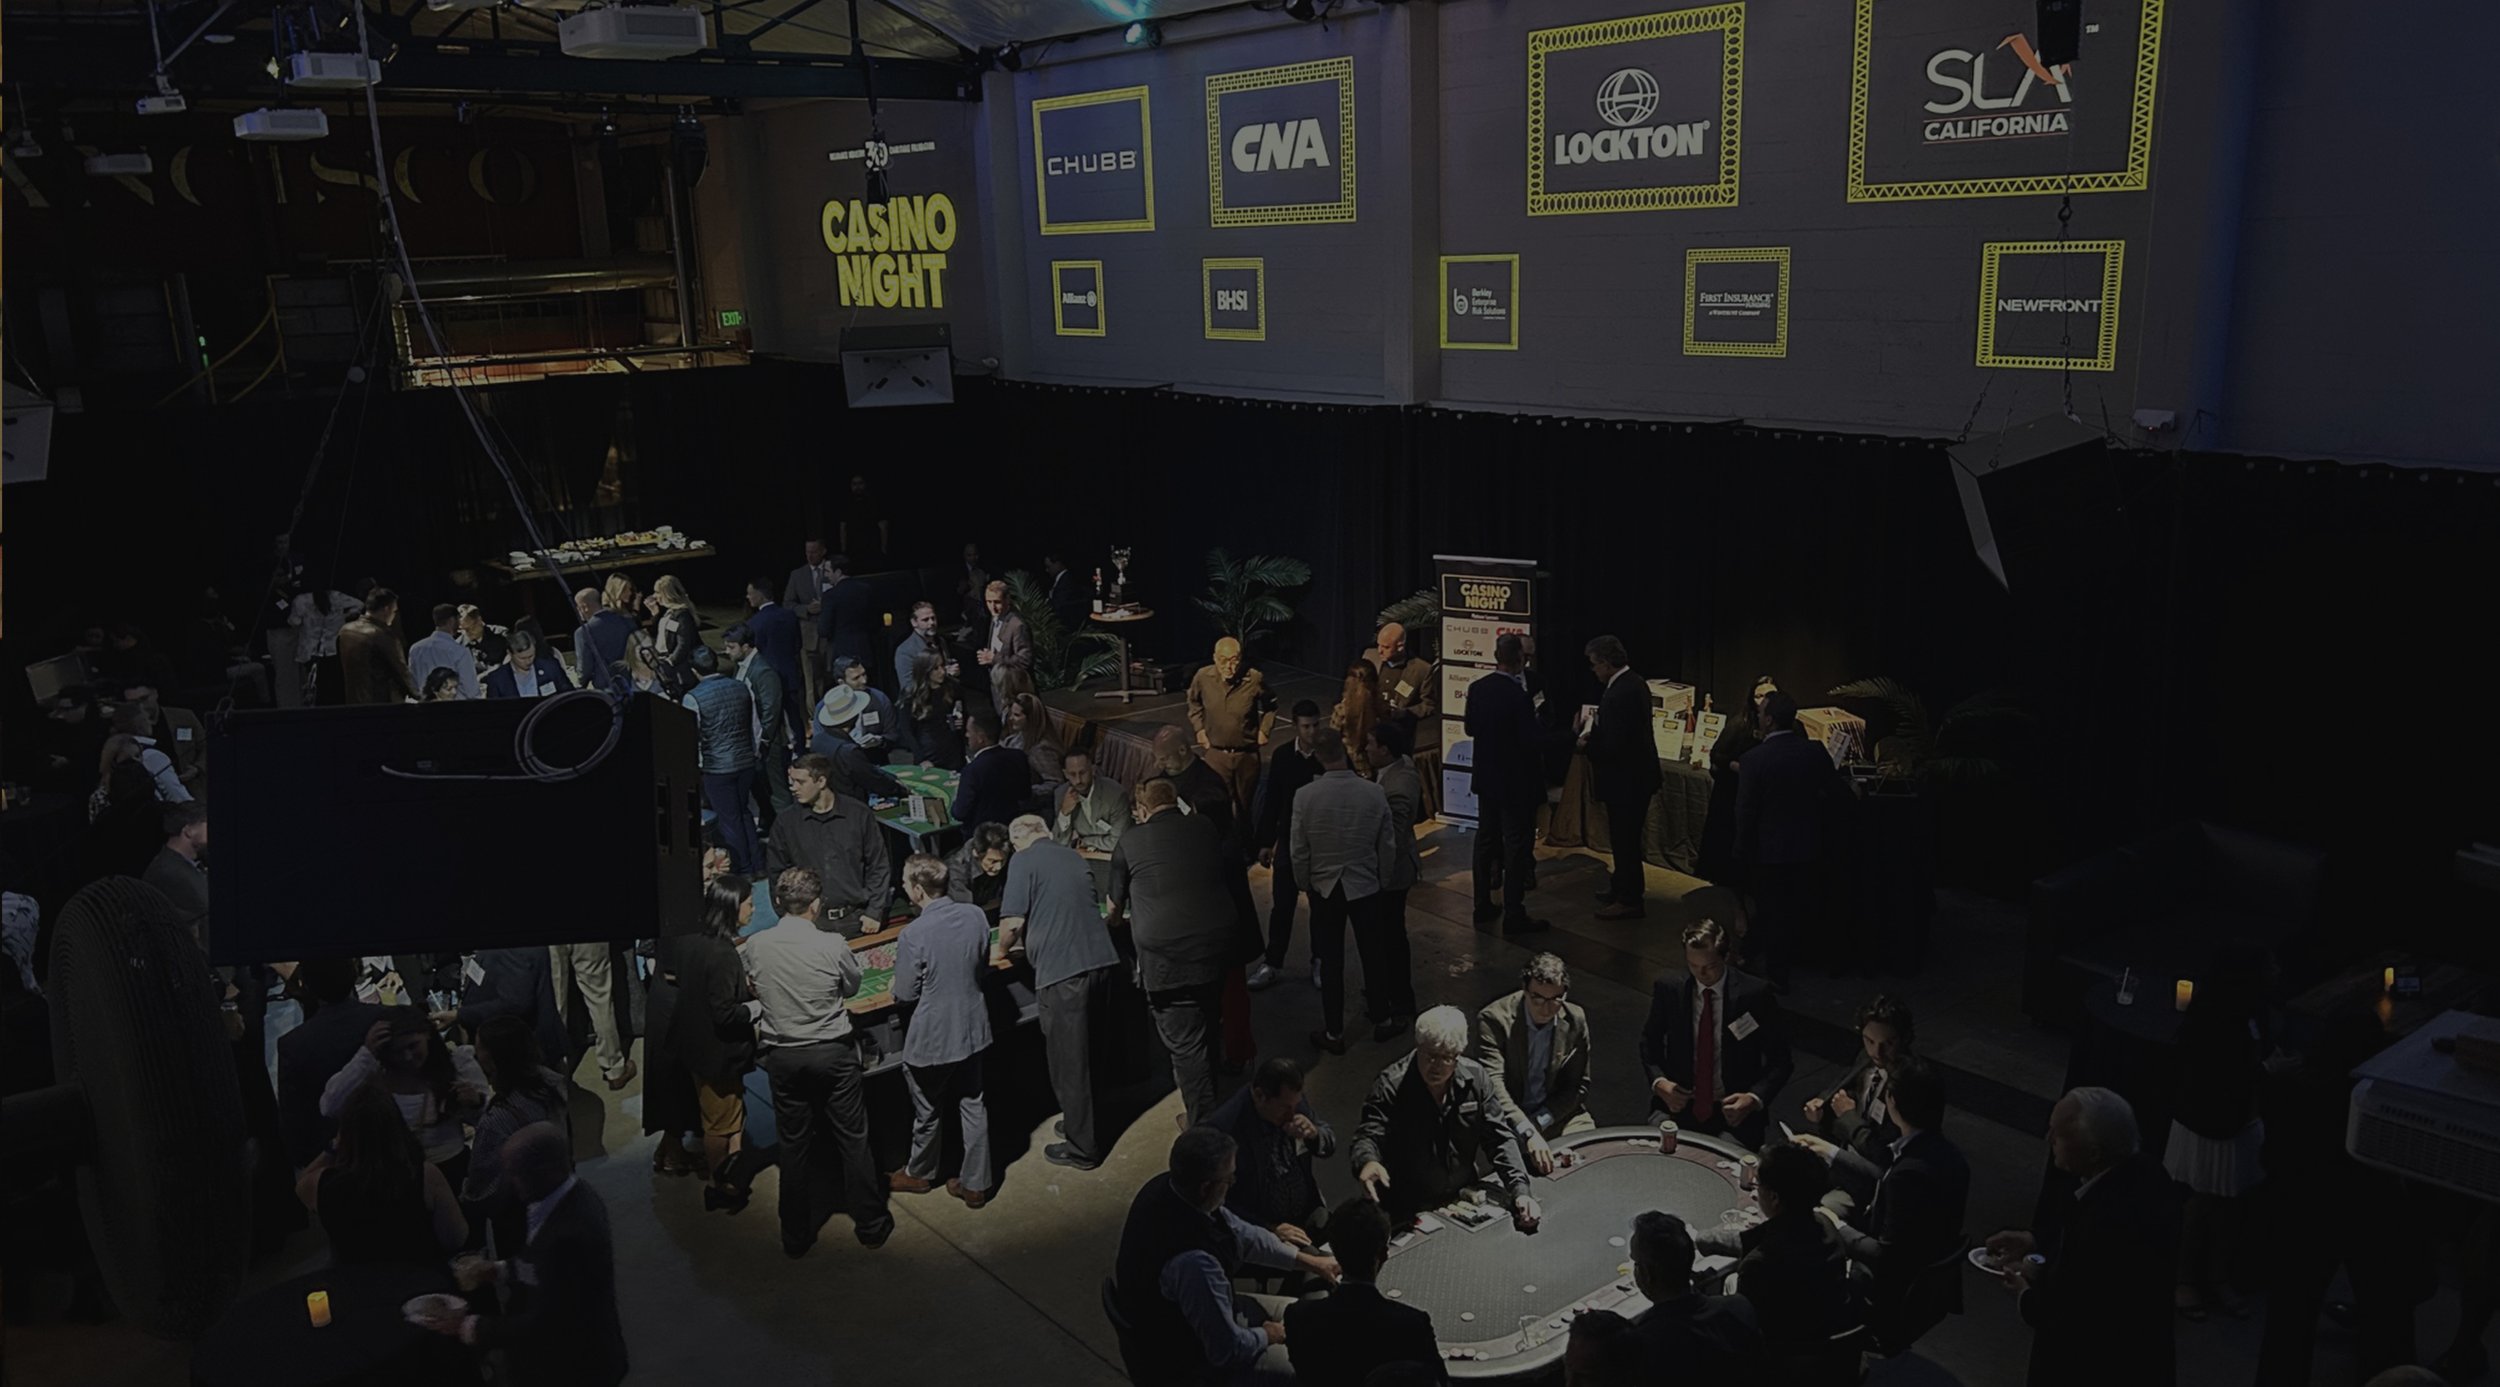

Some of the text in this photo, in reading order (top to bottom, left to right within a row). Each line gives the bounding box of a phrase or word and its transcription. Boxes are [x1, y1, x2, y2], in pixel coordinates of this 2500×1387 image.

[1923, 113, 2069, 141] CALIFORNIA
[1231, 118, 1331, 172] CNA
[1554, 121, 1704, 165] LOCKTON
[1047, 150, 1136, 176] CHUBB
[821, 192, 957, 254] CASINO
[836, 252, 947, 309] NIGHT
[1216, 289, 1248, 312] BHSI
[1997, 298, 2102, 313] NEWFRONT
[721, 311, 739, 326] EXIT
[1460, 583, 1511, 599] CASINO
[1464, 596, 1507, 611] NIGHT
[1446, 624, 1489, 635] CHUBB
